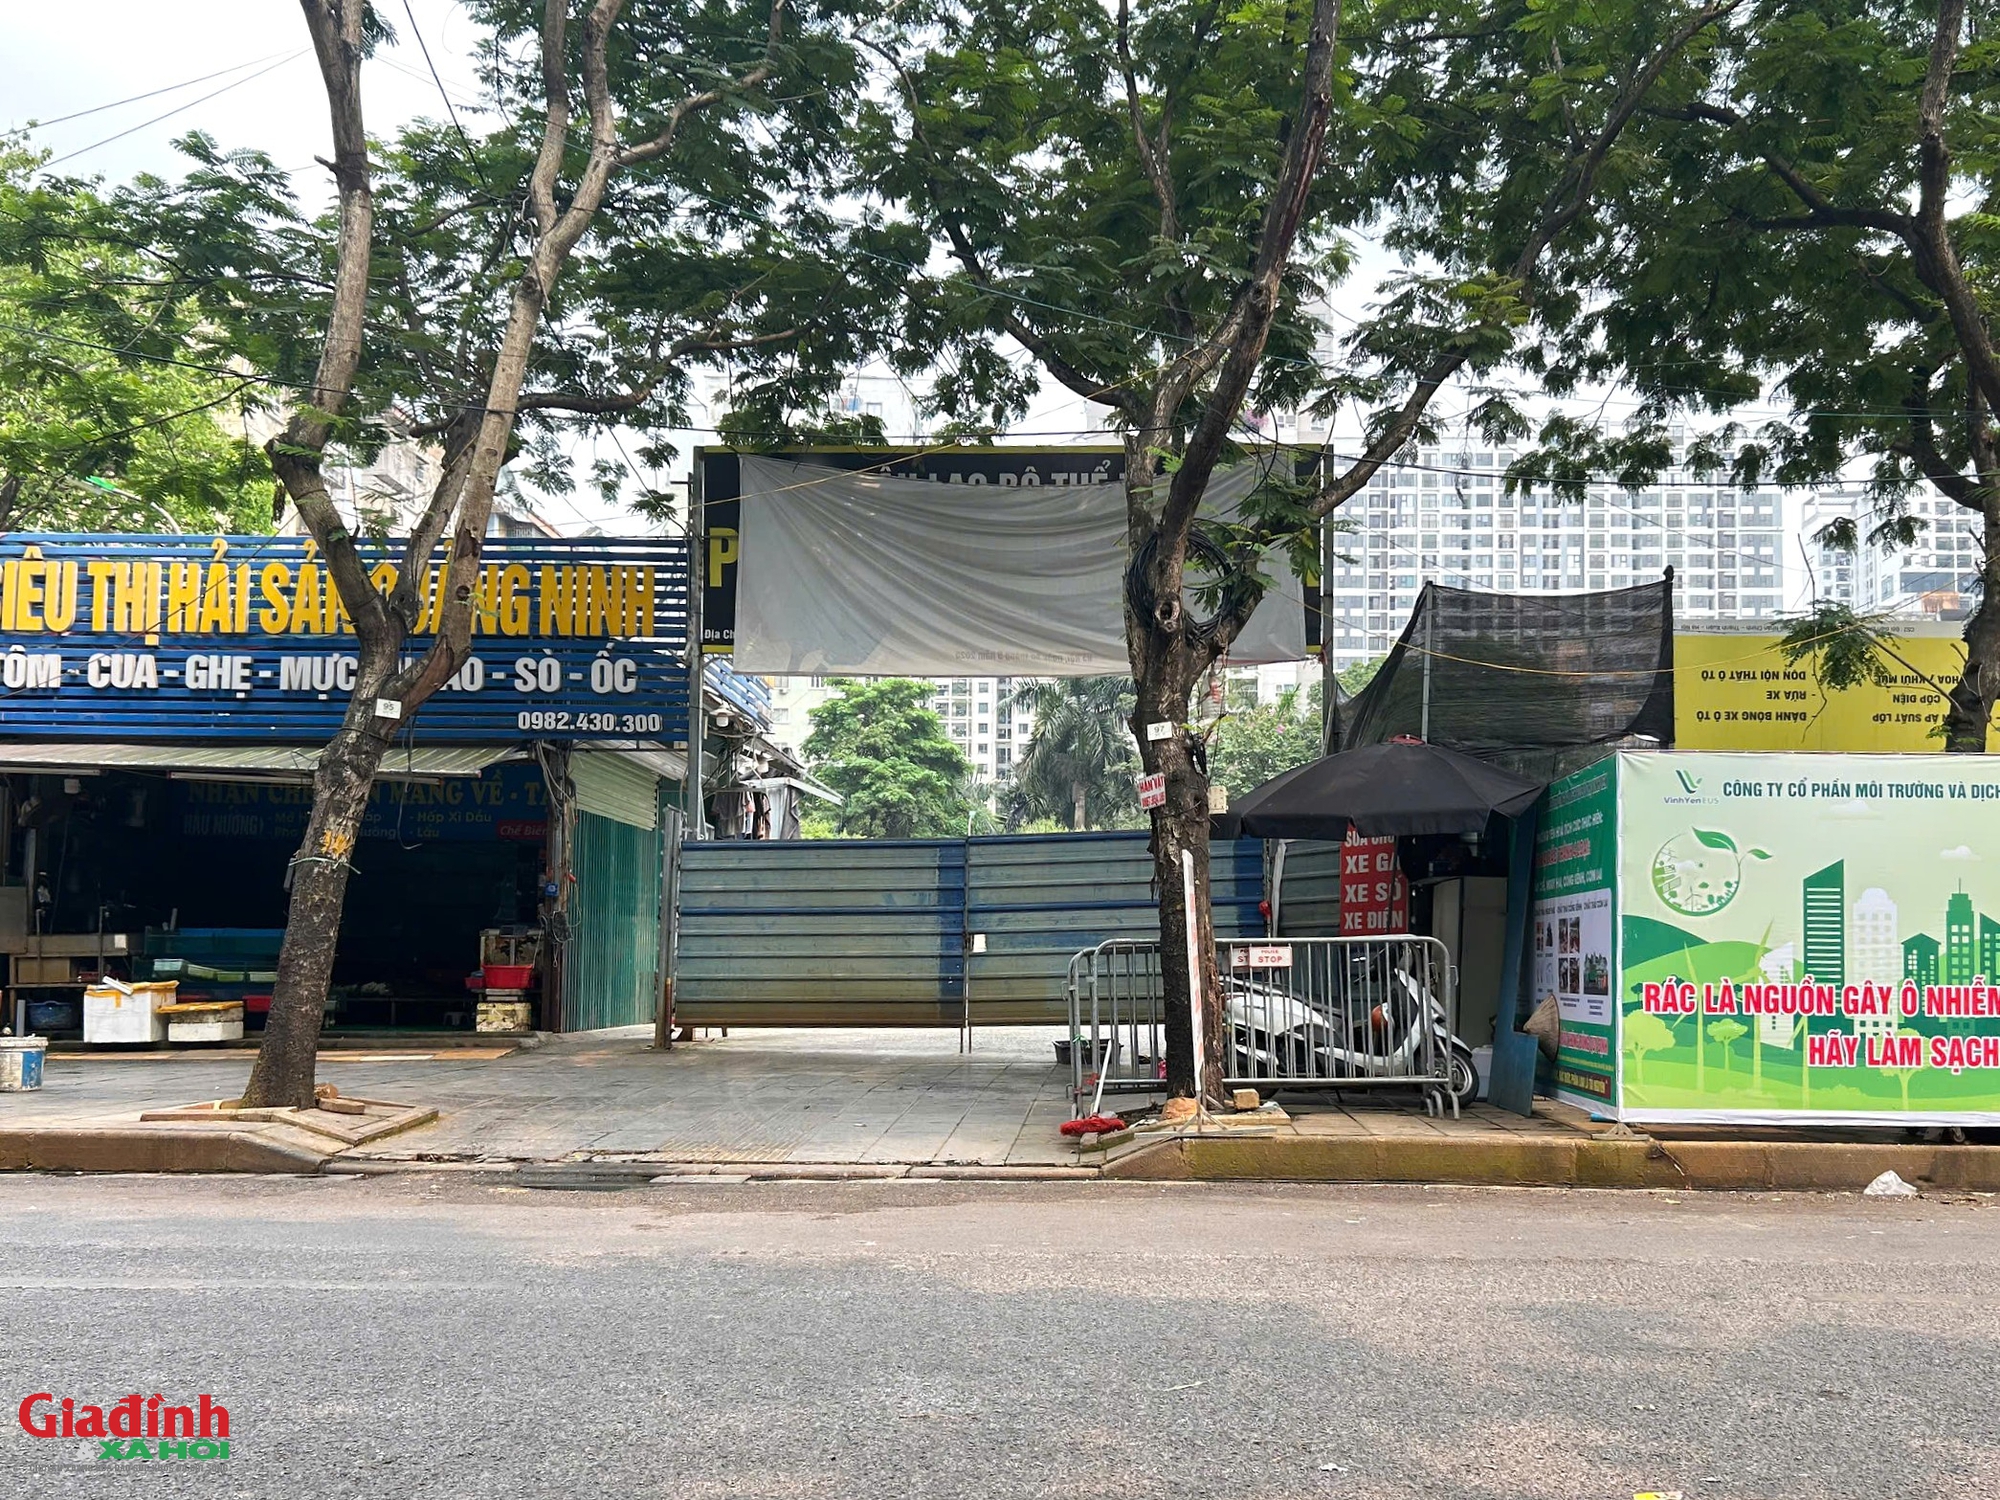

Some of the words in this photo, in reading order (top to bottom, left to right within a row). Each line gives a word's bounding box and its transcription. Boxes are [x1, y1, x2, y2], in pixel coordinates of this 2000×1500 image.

[87, 561, 163, 646] THỊ
[167, 537, 250, 634] HẢI
[539, 565, 655, 637] NINH
[704, 629, 720, 641] Địa
[0, 644, 62, 690] ÔM
[87, 653, 159, 689] CUA
[185, 653, 253, 699] GHẸ
[280, 652, 357, 699] MỰC
[514, 648, 563, 693] SÒ
[590, 642, 638, 693] ỐC
[1701, 670, 1715, 682] TÔ
[1718, 670, 1726, 682] Ô
[1729, 670, 1757, 683] THẤT
[1761, 668, 1780, 682] NỘI
[1783, 668, 1807, 680] DỌN
[1766, 690, 1781, 699] XE
[1892, 693, 1917, 705] ĐIỆN
[1696, 711, 1711, 723] TÔ
[1713, 711, 1722, 723] Ô
[1724, 711, 1739, 720] XE
[1741, 711, 1772, 723] BÓNG
[1775, 711, 1807, 723] ĐÁNH
[1894, 713, 1922, 725] SUẤT
[517, 711, 663, 733] 0982.430.300
[1153, 725, 1165, 734] 97
[1723, 779, 1763, 797] CÔNG
[1767, 782, 1784, 797] TY
[1787, 776, 1807, 798] CỔ
[1812, 777, 1851, 798] PHẦN
[1855, 779, 1883, 798] MÔI
[1887, 780, 1944, 799] TRƯỜNG
[1948, 780, 1967, 799] VÀ
[1345, 854, 1369, 875] XE
[1345, 884, 1368, 903] XE
[1344, 912, 1363, 930] XE
[1258, 955, 1283, 963] STOP
[1644, 978, 1695, 1013] RÁC
[1705, 978, 1735, 1014] LÀ
[1745, 975, 1835, 1015] NGUỒN
[1843, 980, 1892, 1014] GÂY
[1902, 982, 1918, 1014] Ô
[1809, 1031, 1859, 1066] HÃY
[1867, 1031, 1922, 1067] LÀM
[1931, 1036, 2000, 1073] SẠCH
